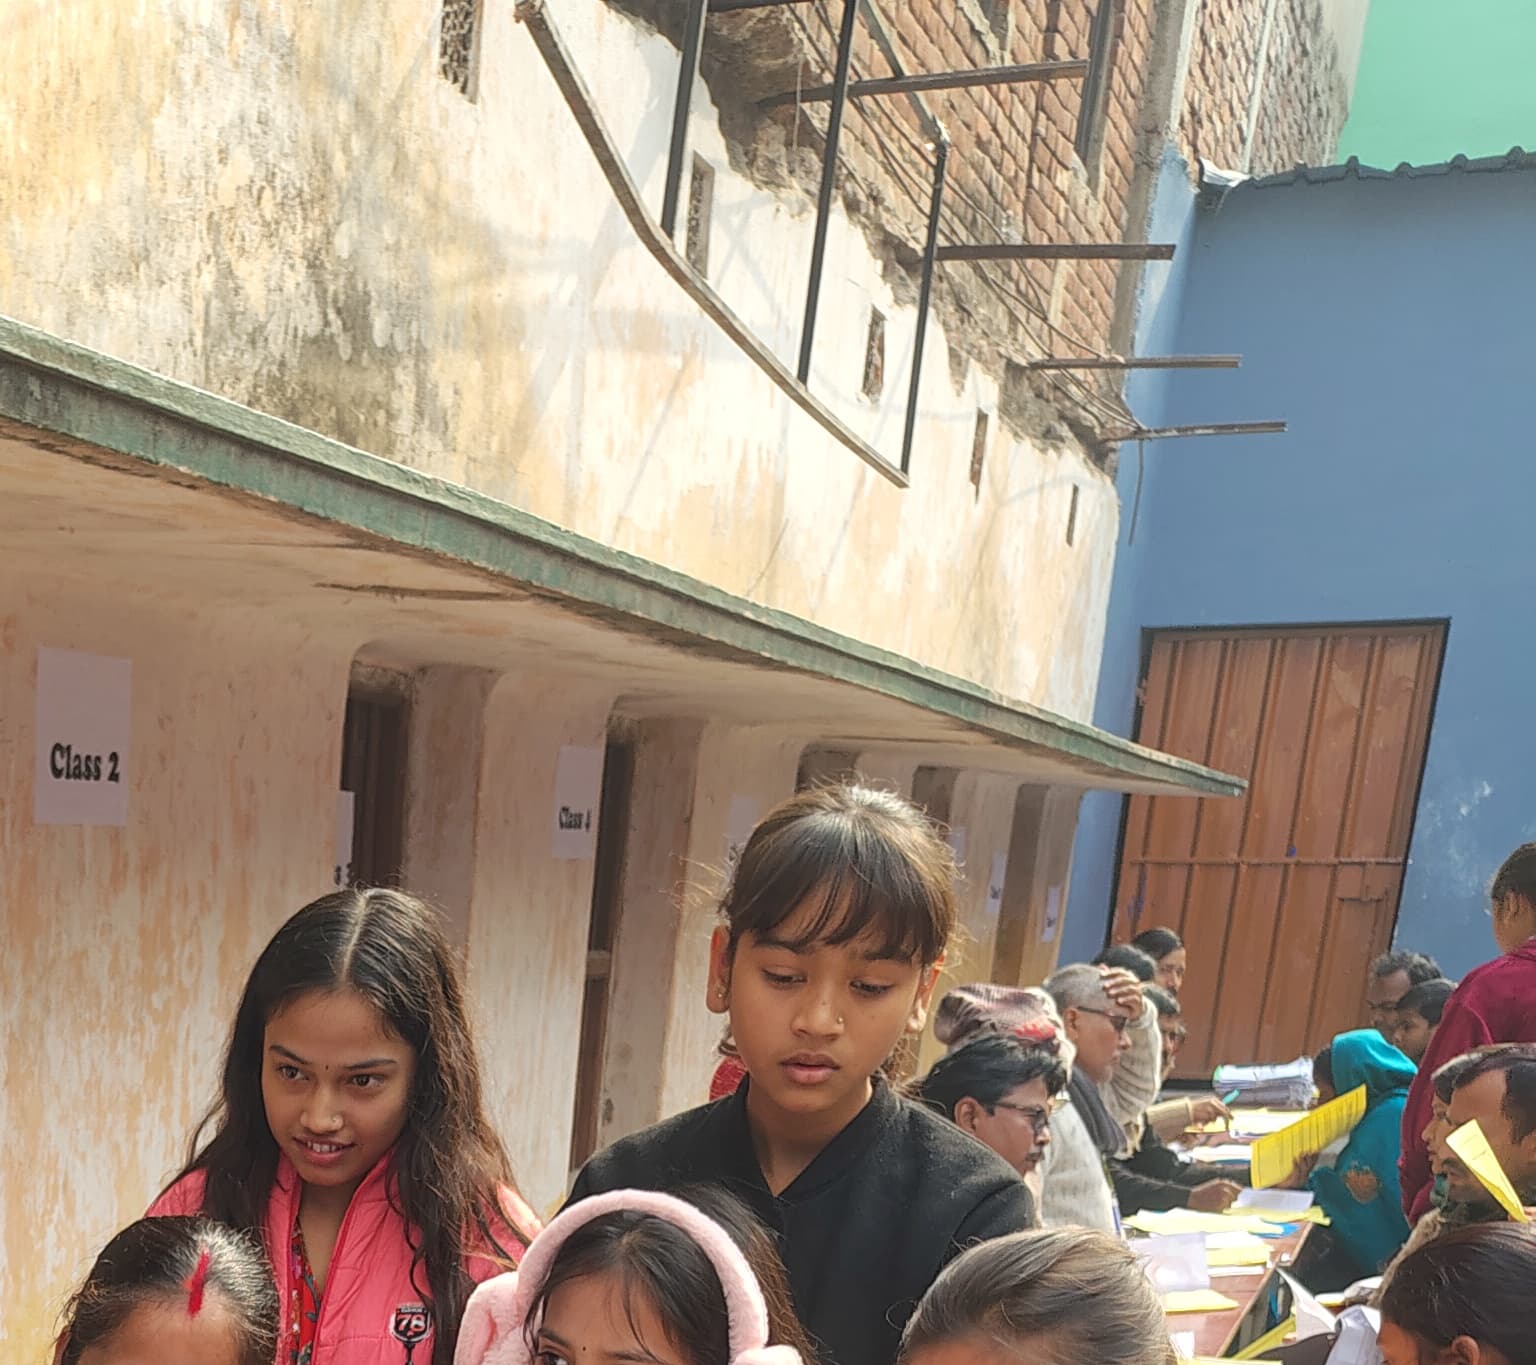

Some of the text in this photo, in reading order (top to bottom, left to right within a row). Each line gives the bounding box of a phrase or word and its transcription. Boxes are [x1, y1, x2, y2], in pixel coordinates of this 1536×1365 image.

[50, 742, 120, 782] Class 2
[397, 1313, 427, 1332] 78
